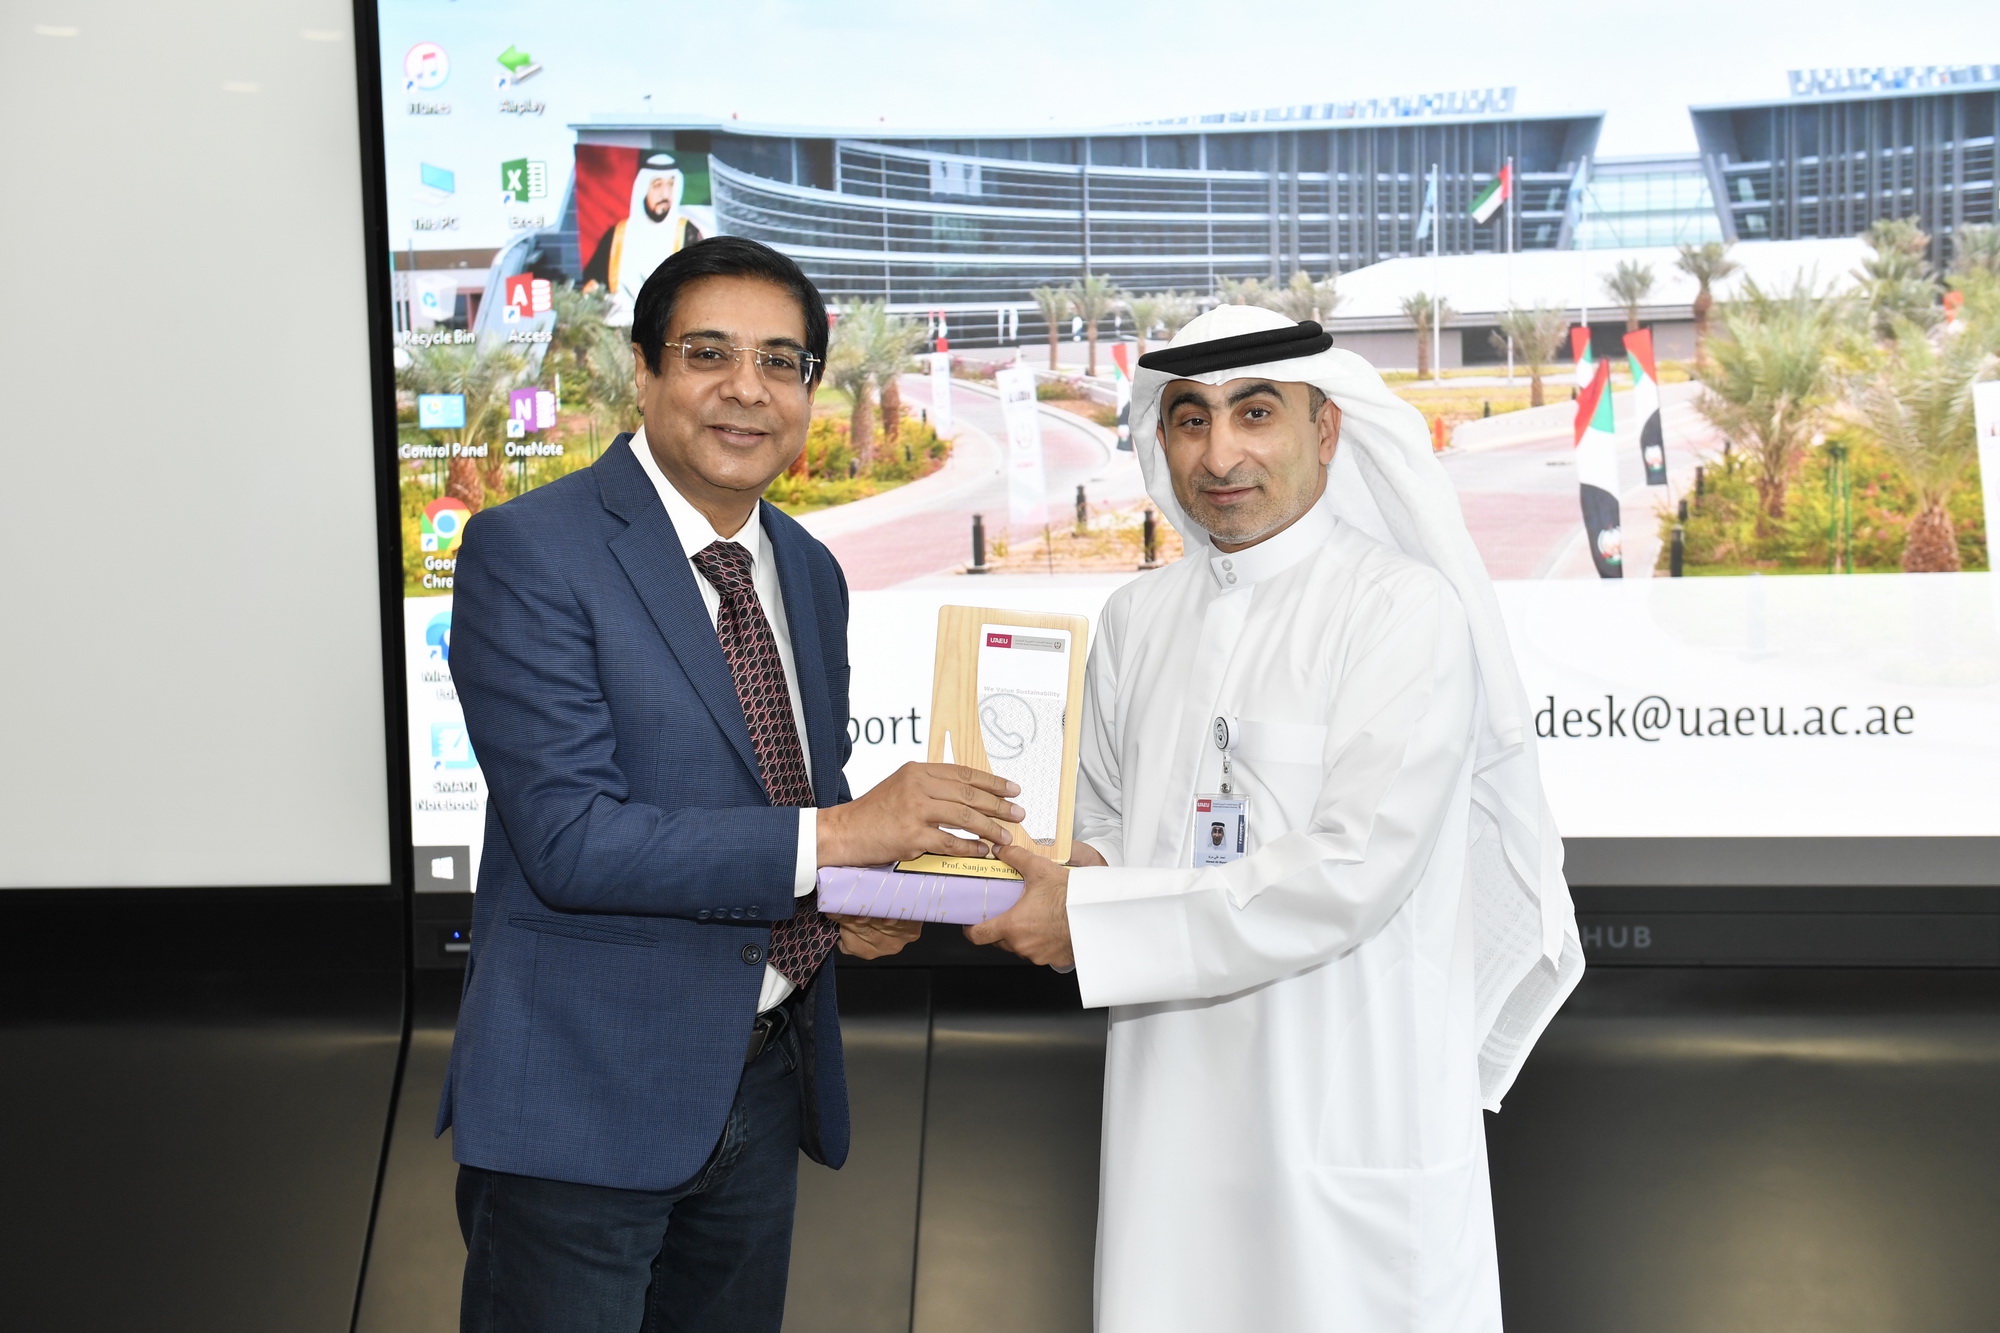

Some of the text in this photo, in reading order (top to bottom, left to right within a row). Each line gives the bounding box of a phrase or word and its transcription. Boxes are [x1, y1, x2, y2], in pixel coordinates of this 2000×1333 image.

[403, 328, 476, 348] Recycle Bin
[508, 328, 553, 343] Access
[401, 442, 488, 459] Control Panel
[505, 441, 564, 457] OneNote
[996, 686, 1015, 694] Value
[1016, 688, 1060, 697] Sustainability
[1534, 694, 1915, 741] desk@uaeu.ac.ae
[941, 861, 960, 869] Prof.
[962, 863, 989, 873] Sanjay
[1582, 925, 1652, 949] HUB
